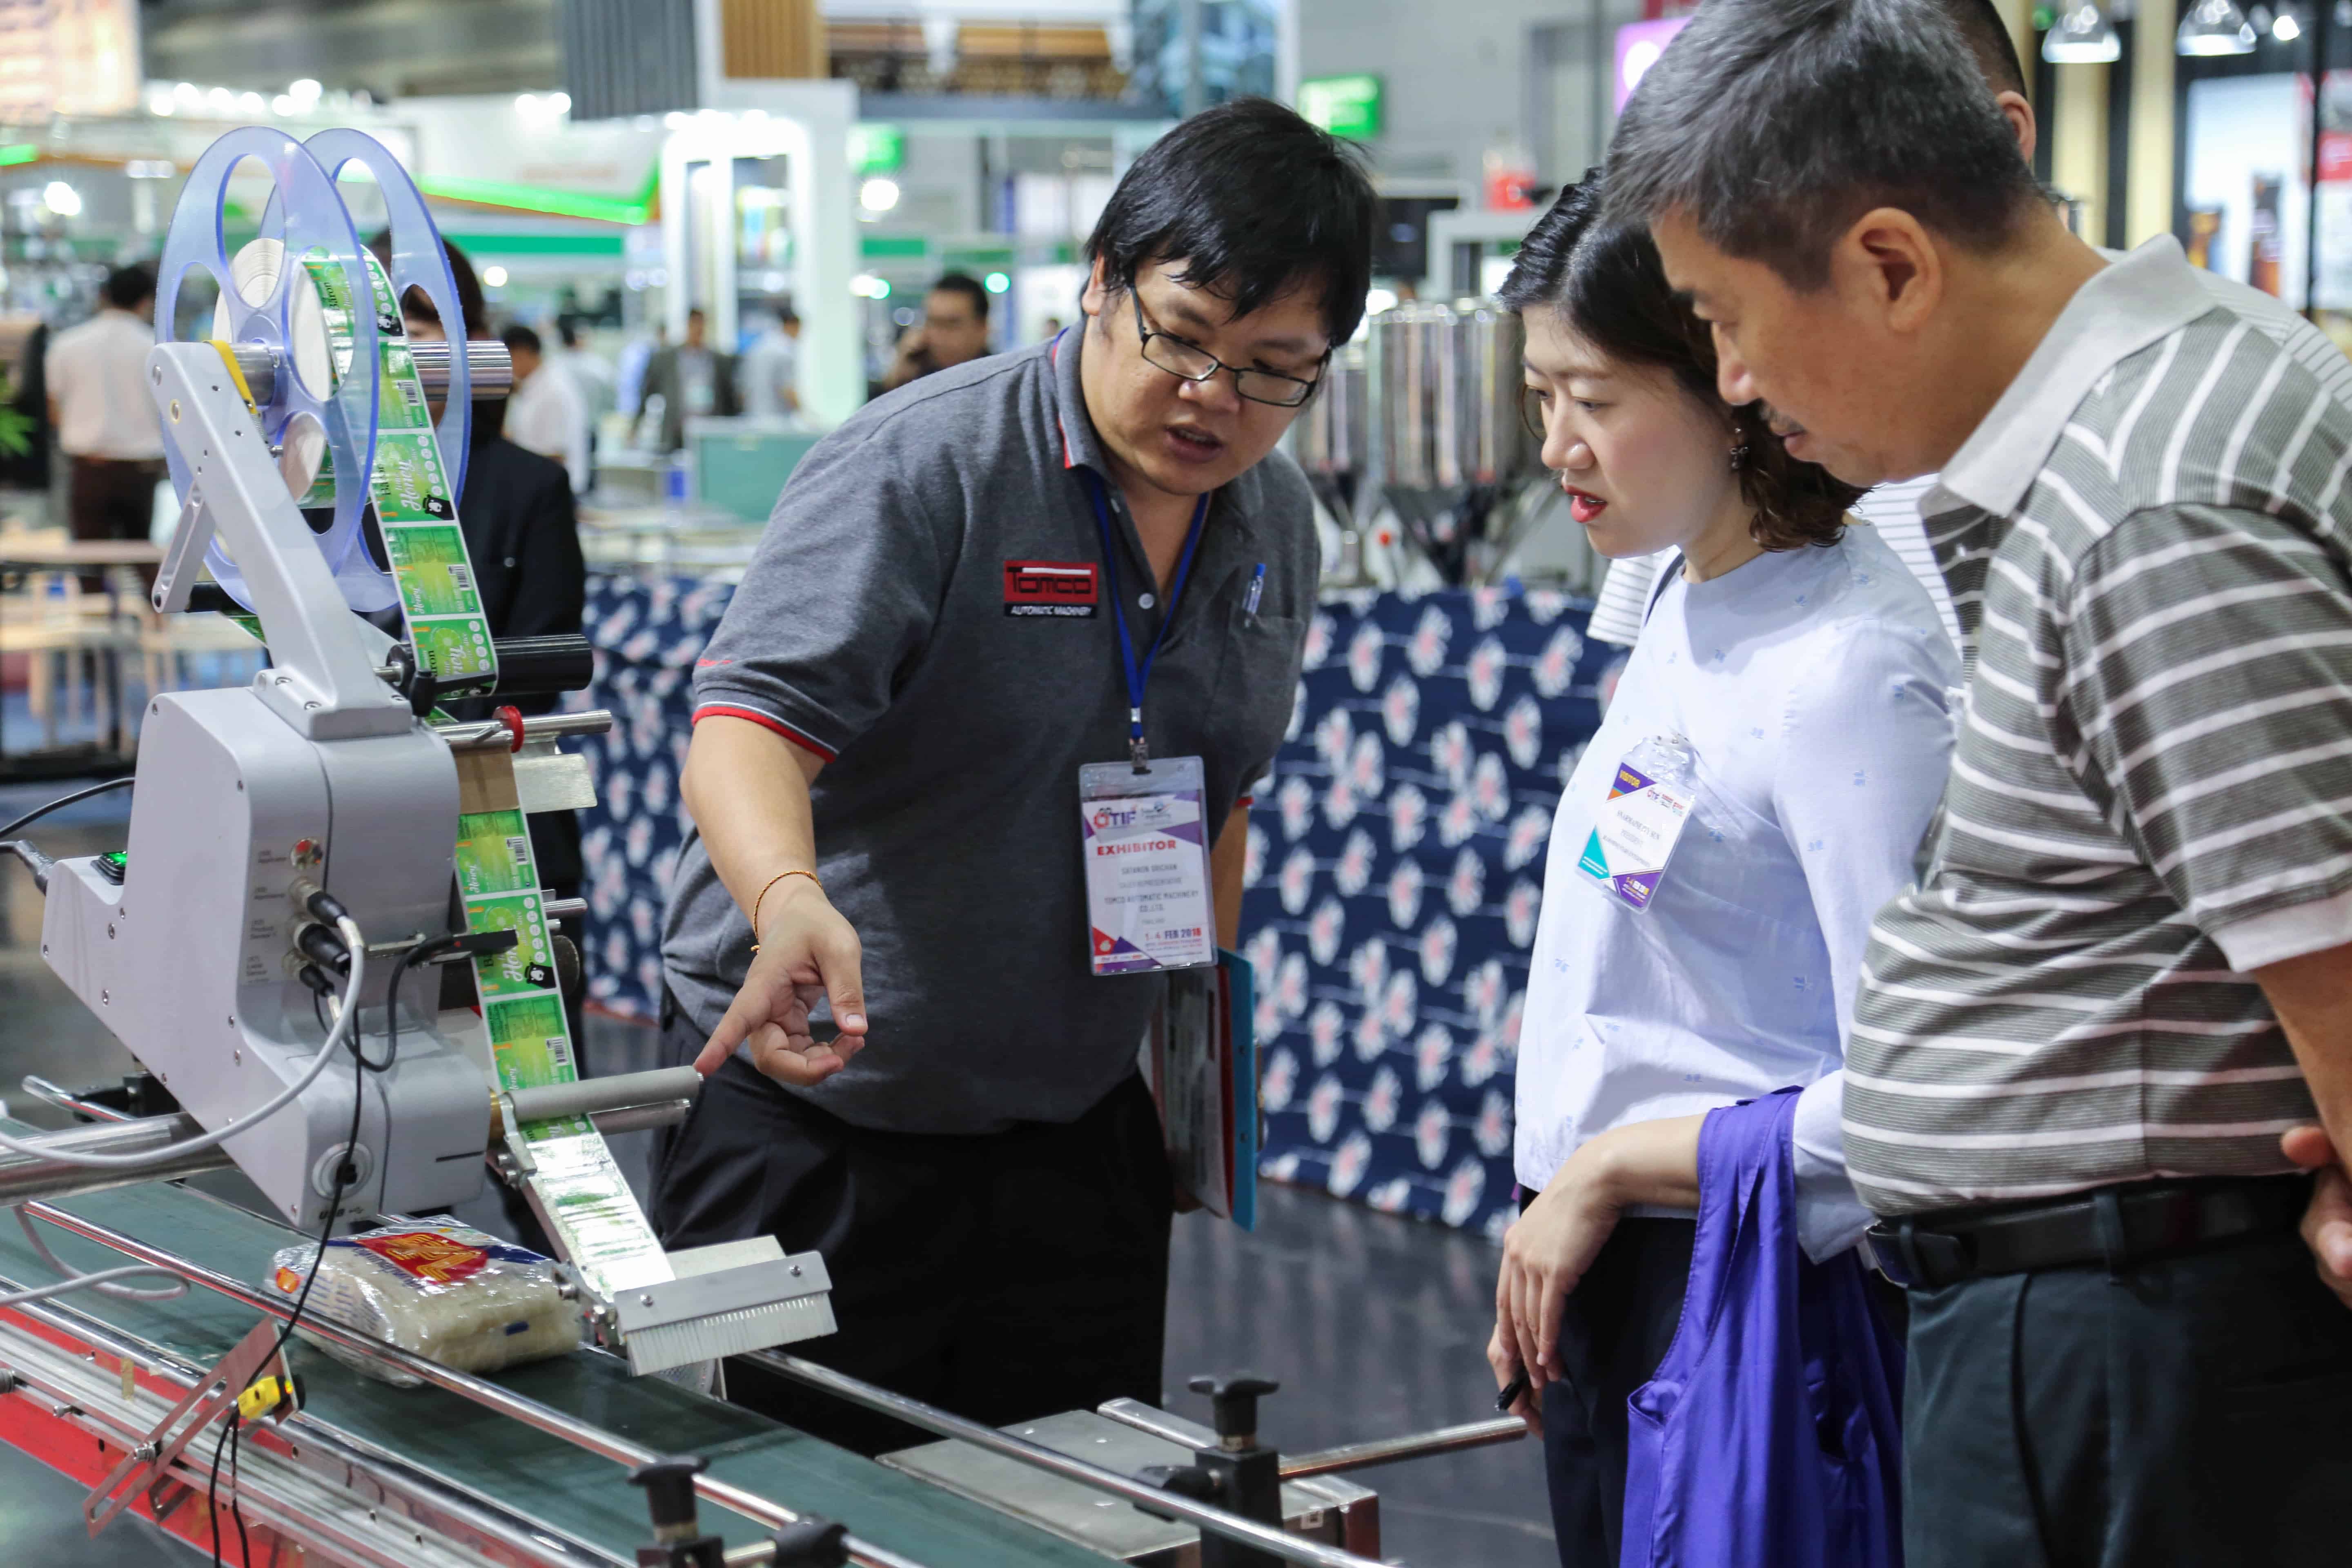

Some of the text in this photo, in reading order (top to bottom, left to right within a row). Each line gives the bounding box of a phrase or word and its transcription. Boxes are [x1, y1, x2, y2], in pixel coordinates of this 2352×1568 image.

[398, 459, 422, 511] Honey
[1097, 839, 1177, 856] EXHIBITOR
[1165, 929, 1179, 939] FEB
[318, 1208, 345, 1220] UB
